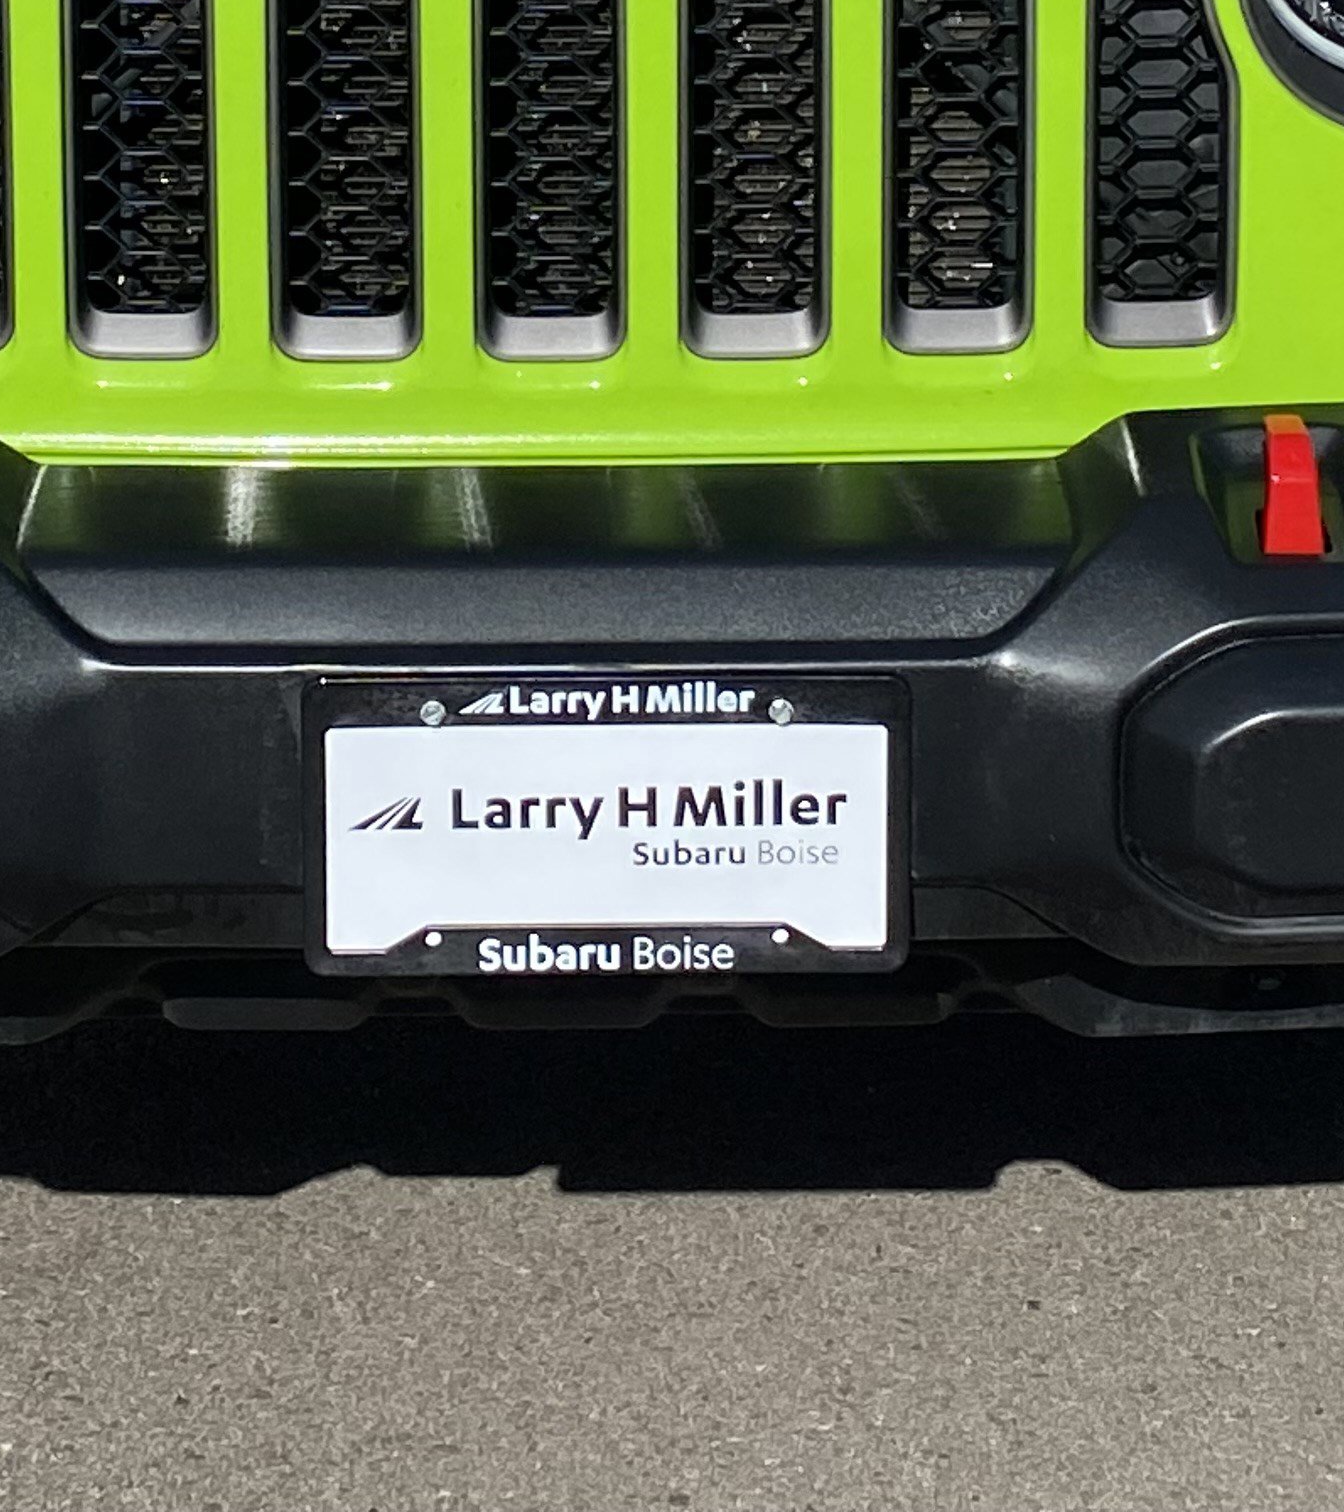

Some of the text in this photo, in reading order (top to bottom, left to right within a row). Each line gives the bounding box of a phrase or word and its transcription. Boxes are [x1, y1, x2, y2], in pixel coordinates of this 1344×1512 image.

[509, 681, 755, 722] Larry H Miller
[452, 779, 848, 840] Larry H Miller
[632, 840, 840, 866] Subaru Boise
[478, 933, 735, 972] Subaru Boise
